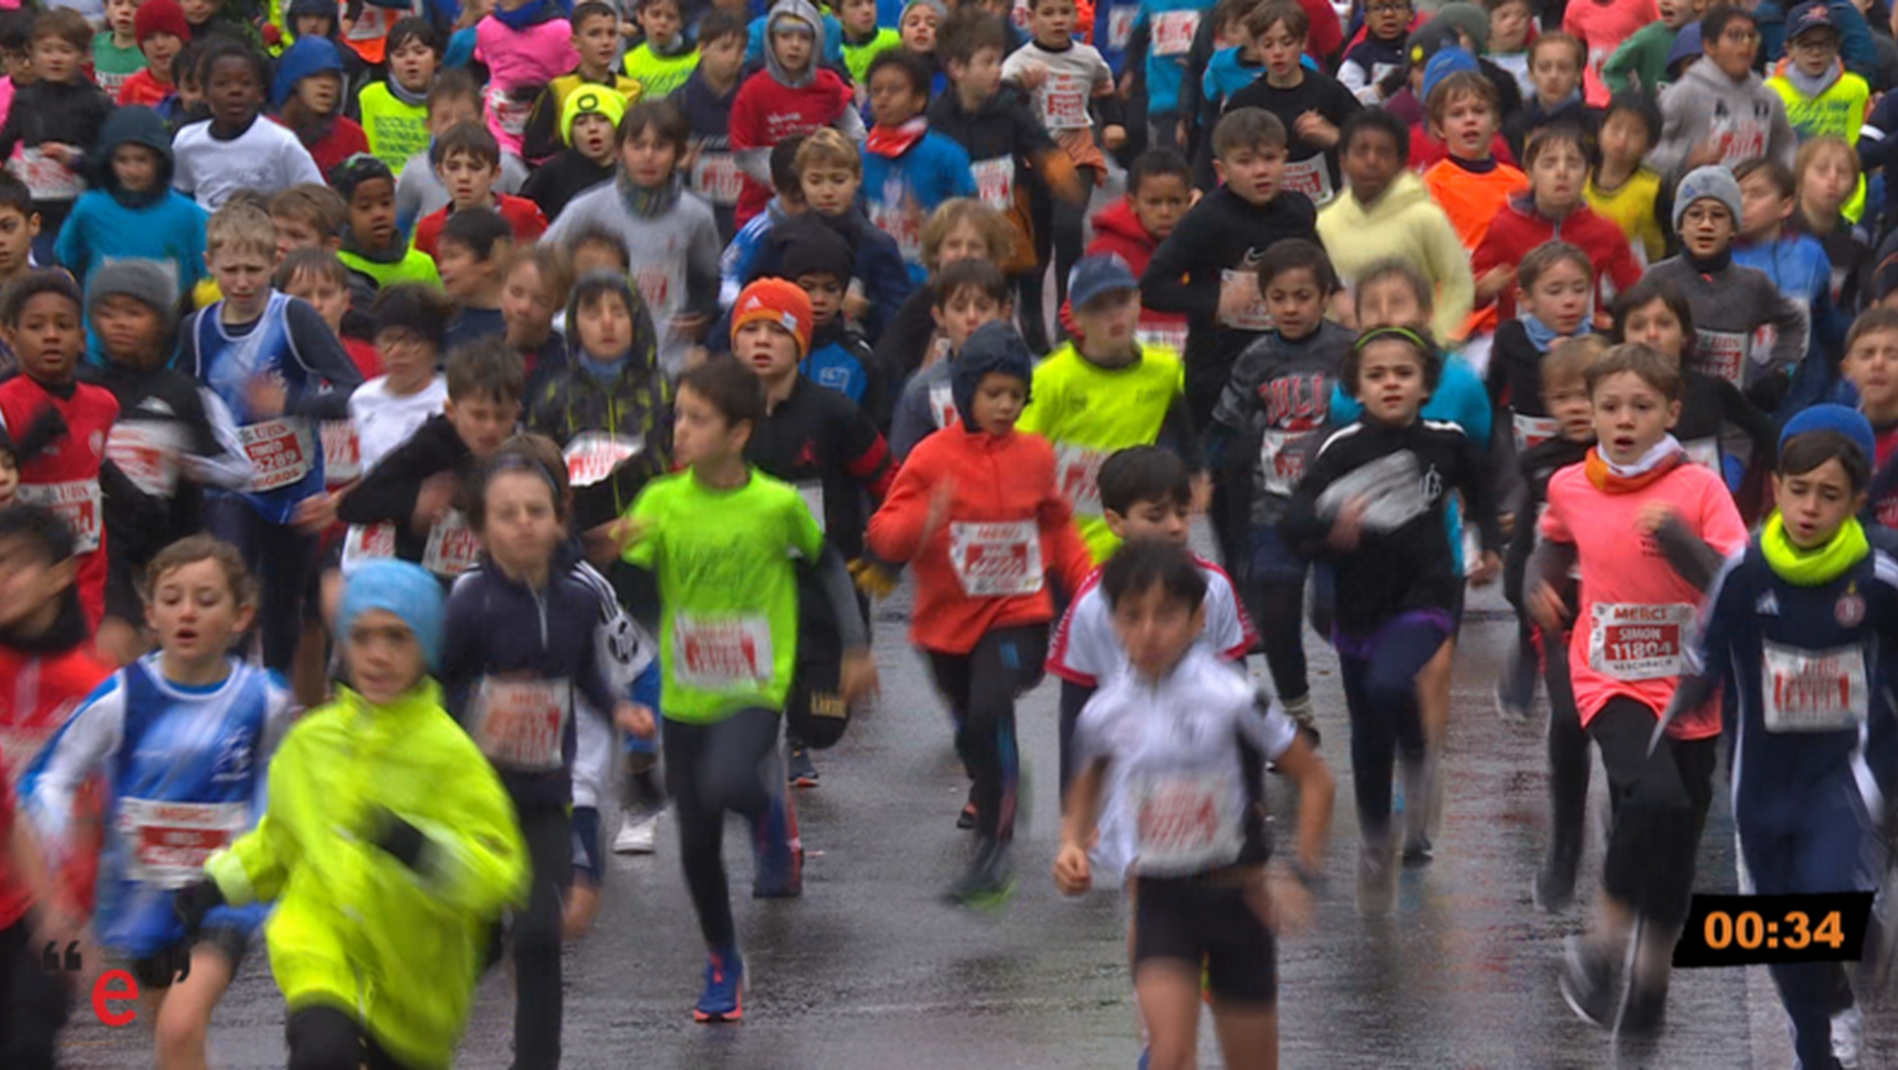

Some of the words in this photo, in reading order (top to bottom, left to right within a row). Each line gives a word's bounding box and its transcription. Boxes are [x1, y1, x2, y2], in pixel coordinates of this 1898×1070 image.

[1613, 606, 1667, 620] MERCI
[1618, 626, 1662, 641] SIMON
[1610, 640, 1673, 660] 11804
